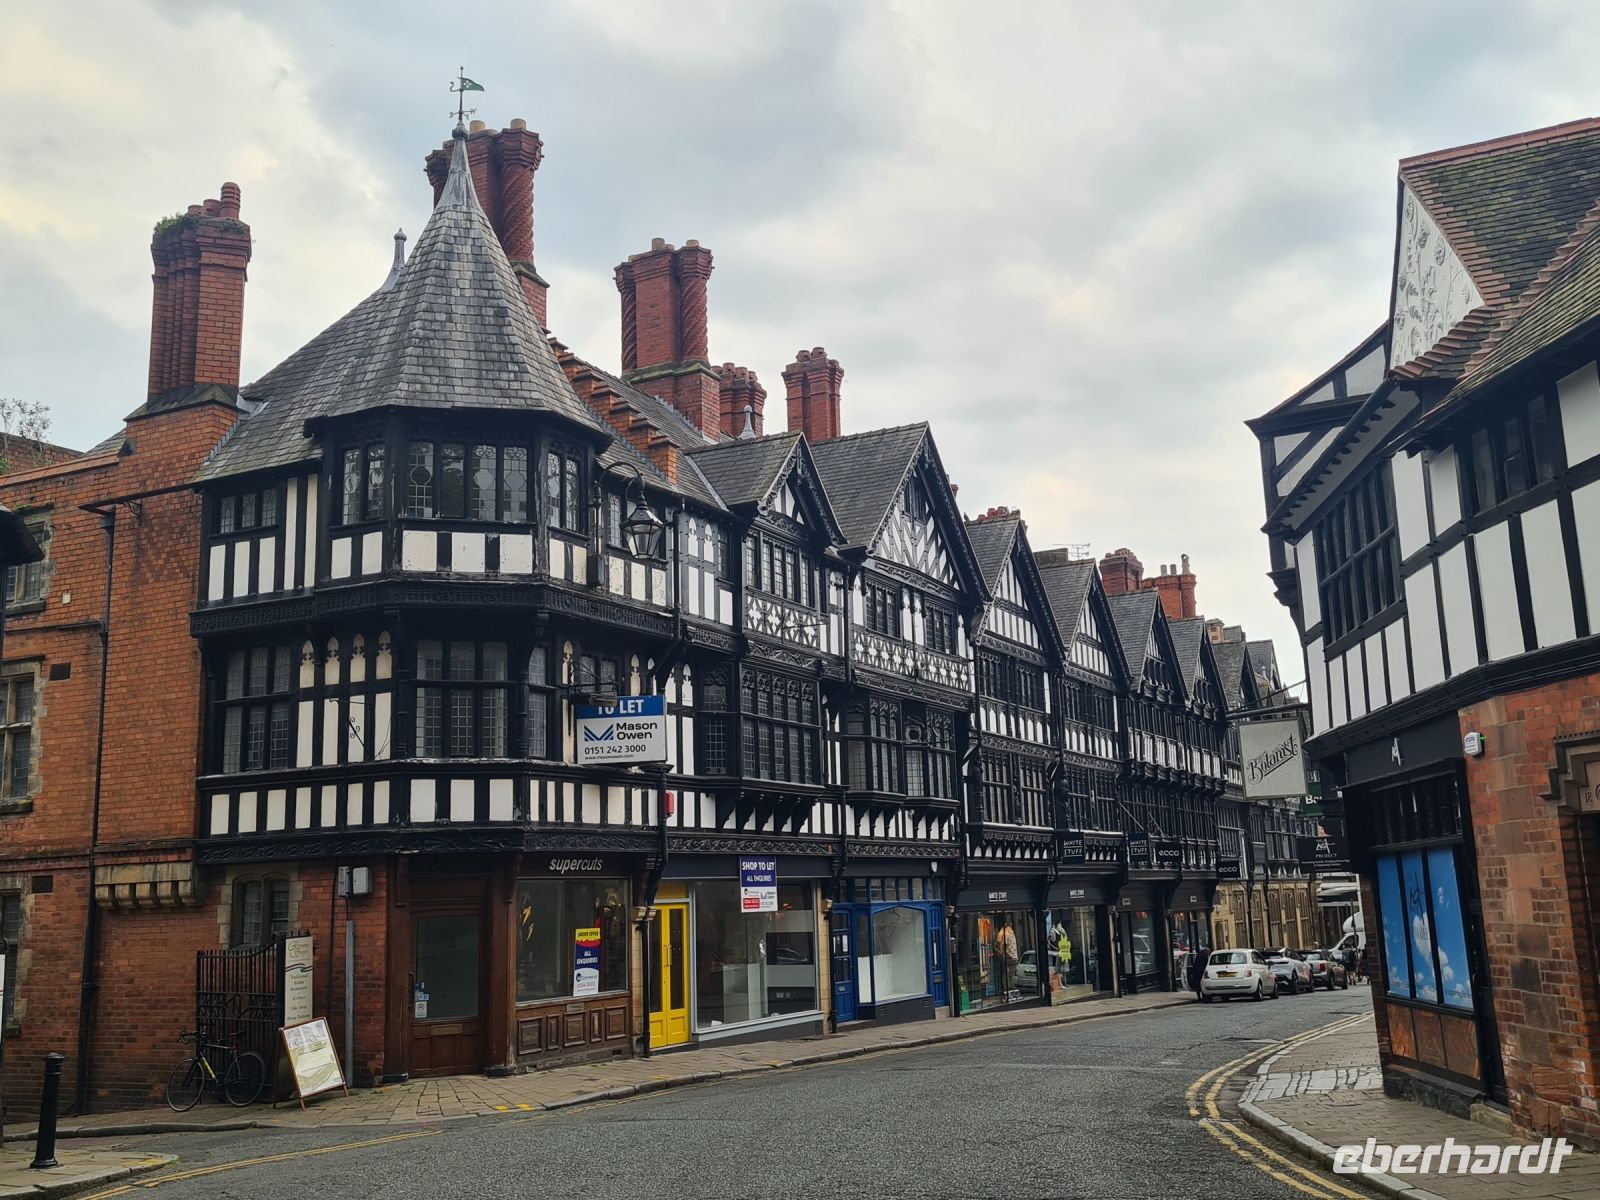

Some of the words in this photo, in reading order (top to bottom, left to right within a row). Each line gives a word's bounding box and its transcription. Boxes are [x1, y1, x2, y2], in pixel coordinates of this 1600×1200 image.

[620, 700, 644, 714] LET
[616, 722, 657, 731] Mason
[617, 731, 652, 740] Owen
[1247, 733, 1298, 785] Botanist
[550, 858, 603, 874] supercuts
[742, 862, 757, 870] SHOP
[758, 862, 766, 870] TO
[766, 862, 774, 870] LET
